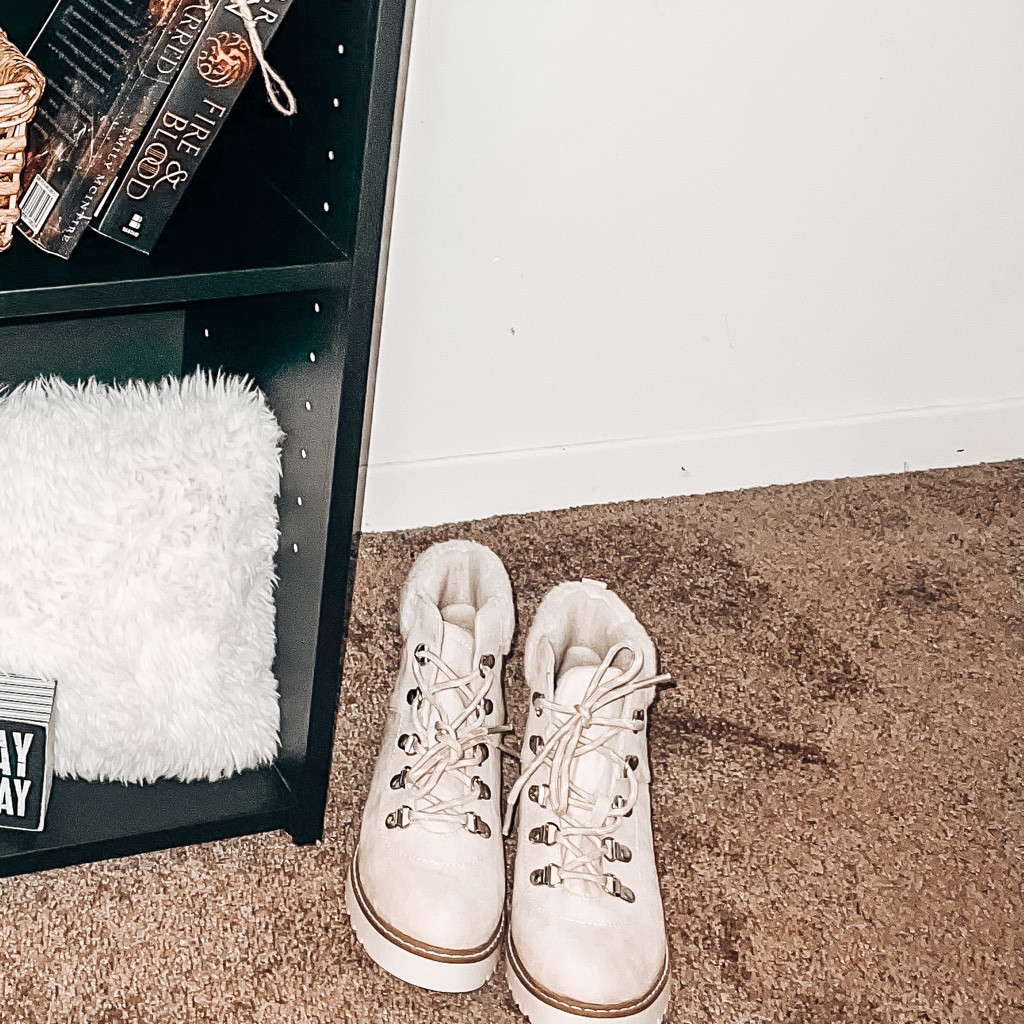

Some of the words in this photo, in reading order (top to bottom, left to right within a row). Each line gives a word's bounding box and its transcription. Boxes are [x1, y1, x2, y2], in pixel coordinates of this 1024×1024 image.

[103, 126, 134, 171] EMILY
[176, 97, 227, 158] FIRE
[126, 111, 189, 200] BLOOD
[152, 160, 189, 190] &
